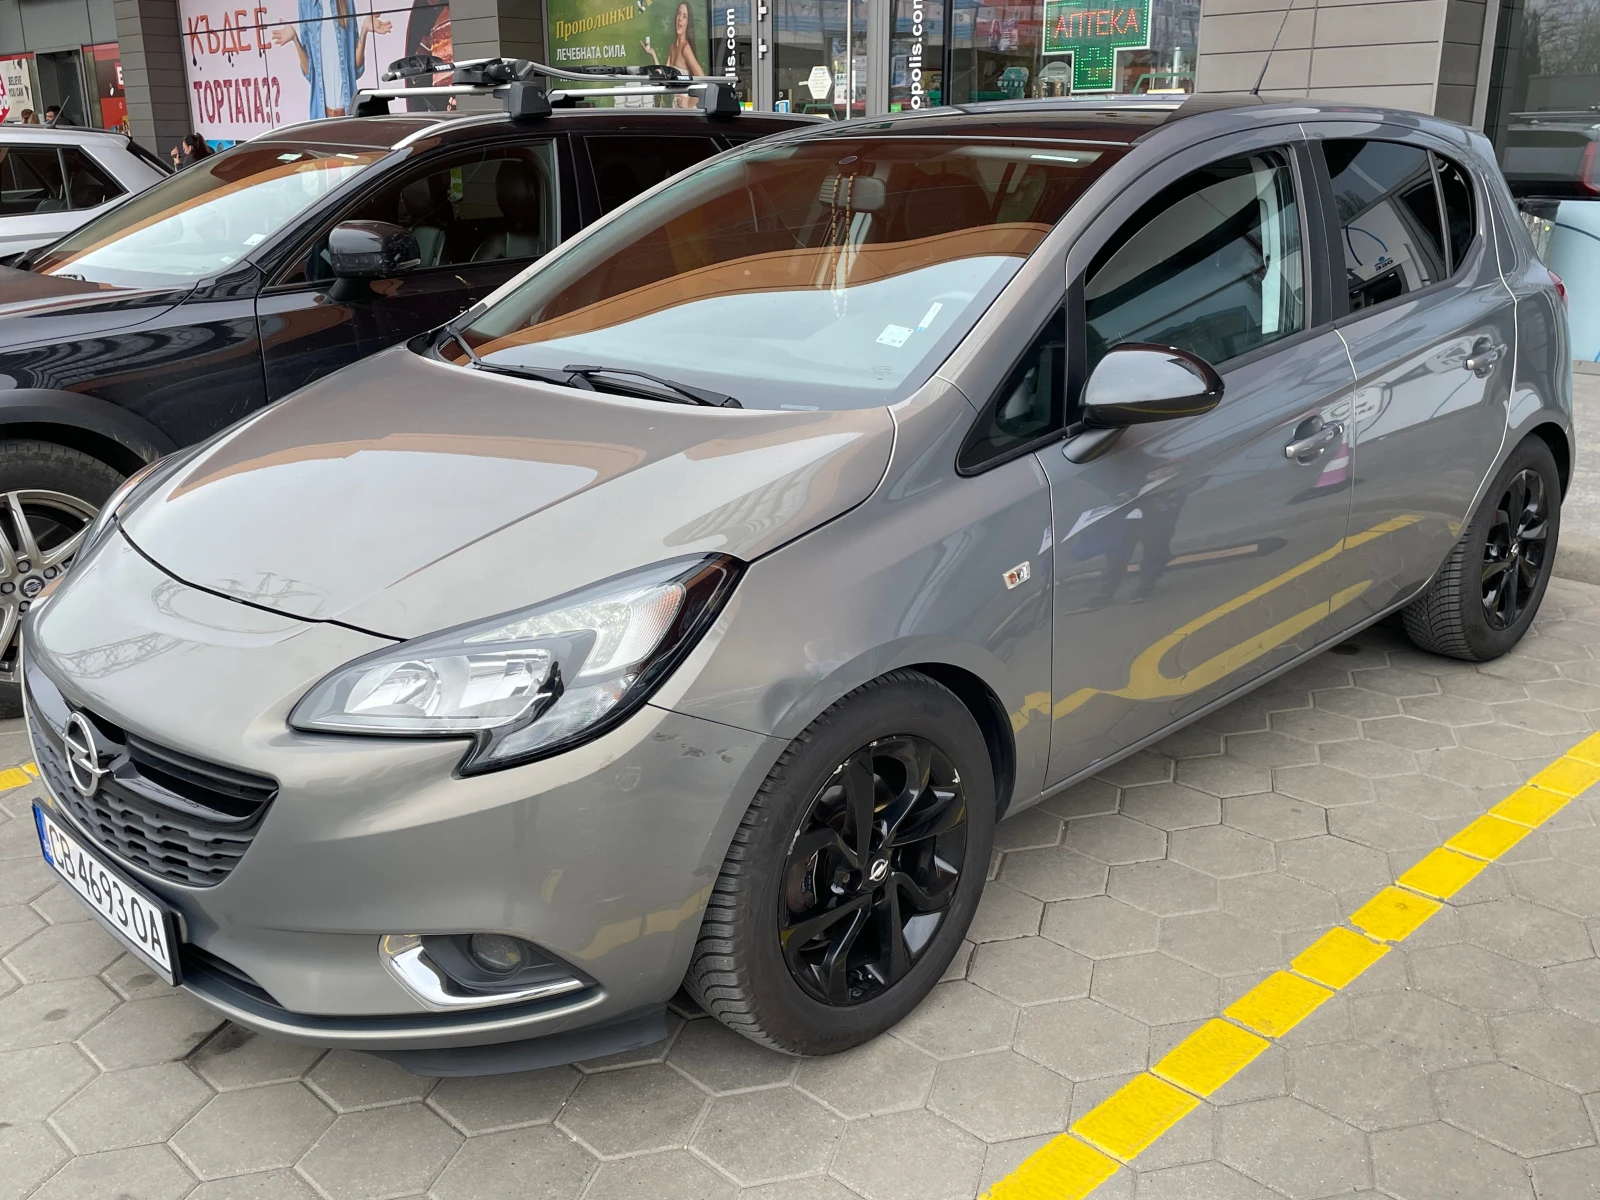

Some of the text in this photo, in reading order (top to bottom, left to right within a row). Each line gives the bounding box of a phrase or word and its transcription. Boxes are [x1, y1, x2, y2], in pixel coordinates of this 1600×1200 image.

[187, 7, 272, 56] КЪДЕ Е
[556, 4, 634, 41] Прополинки
[1054, 8, 1139, 38] АПТЕКА
[556, 44, 627, 61] ЛЕЧЕБНАТА СИЛА
[193, 76, 281, 124] ТОРТАТА??
[78, 851, 128, 928] 4693
